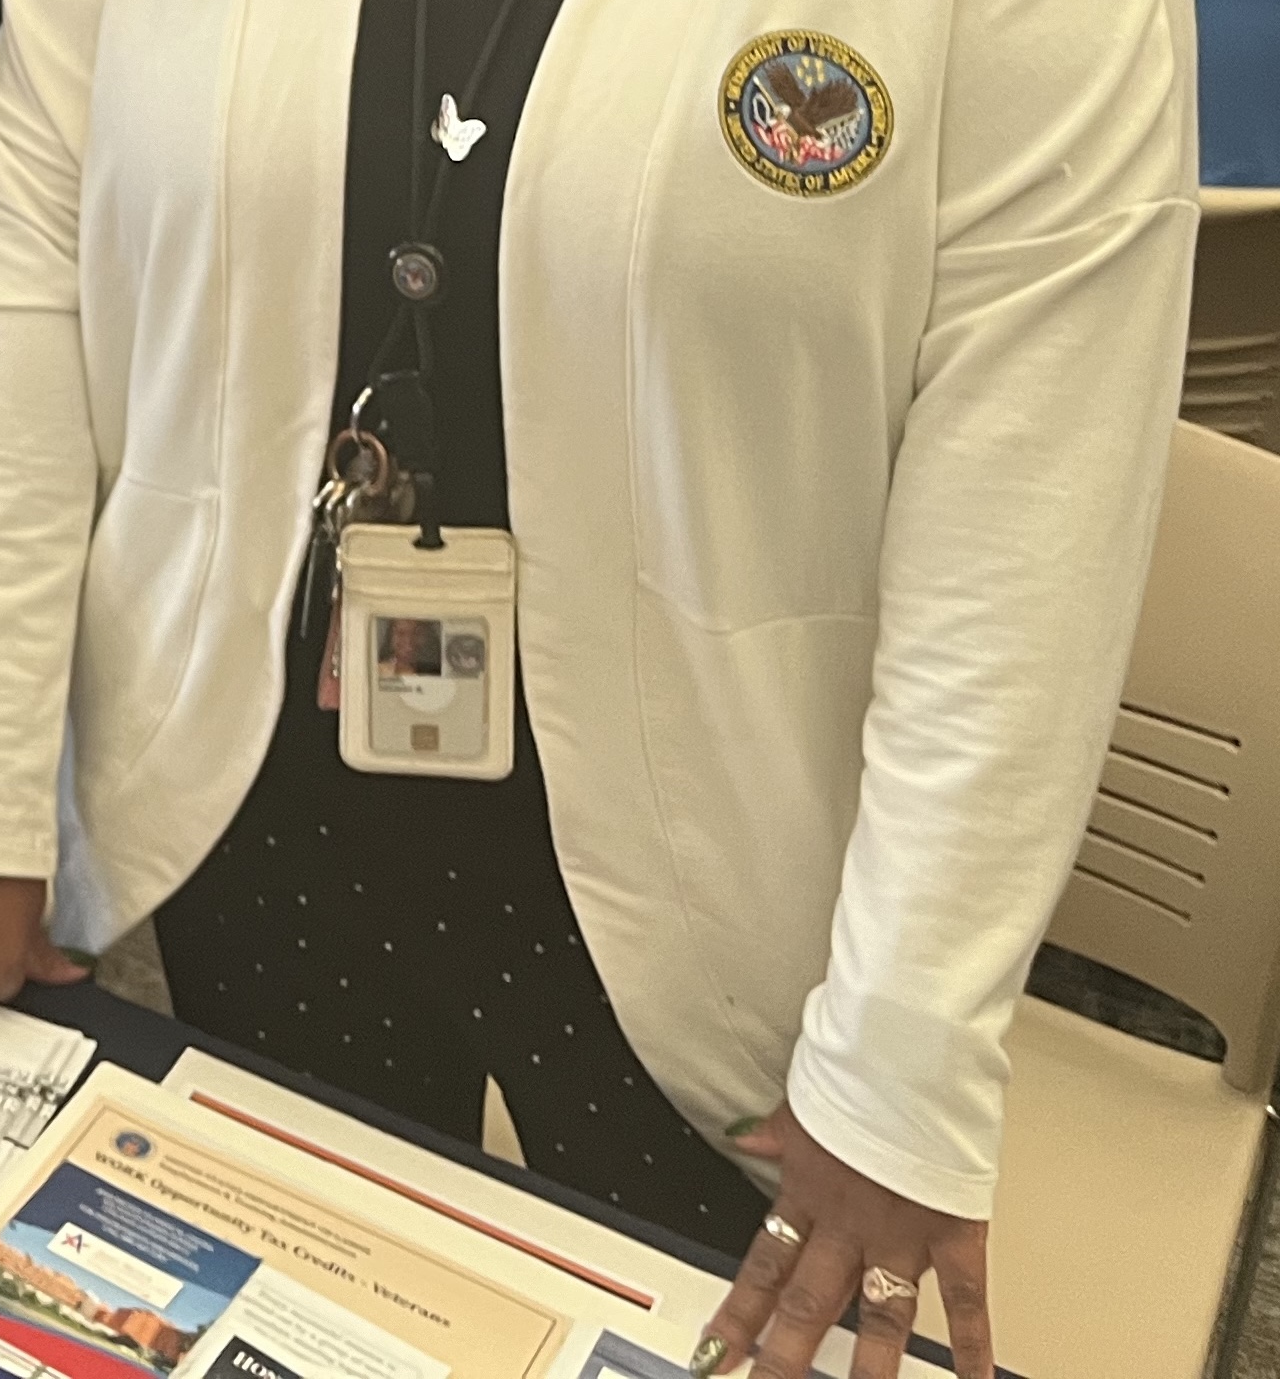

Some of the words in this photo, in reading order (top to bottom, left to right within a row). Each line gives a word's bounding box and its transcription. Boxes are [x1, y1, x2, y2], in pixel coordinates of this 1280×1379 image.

[259, 1227, 287, 1252] Tax
[292, 1244, 356, 1283] Credits
[372, 1280, 452, 1329] Veterans
